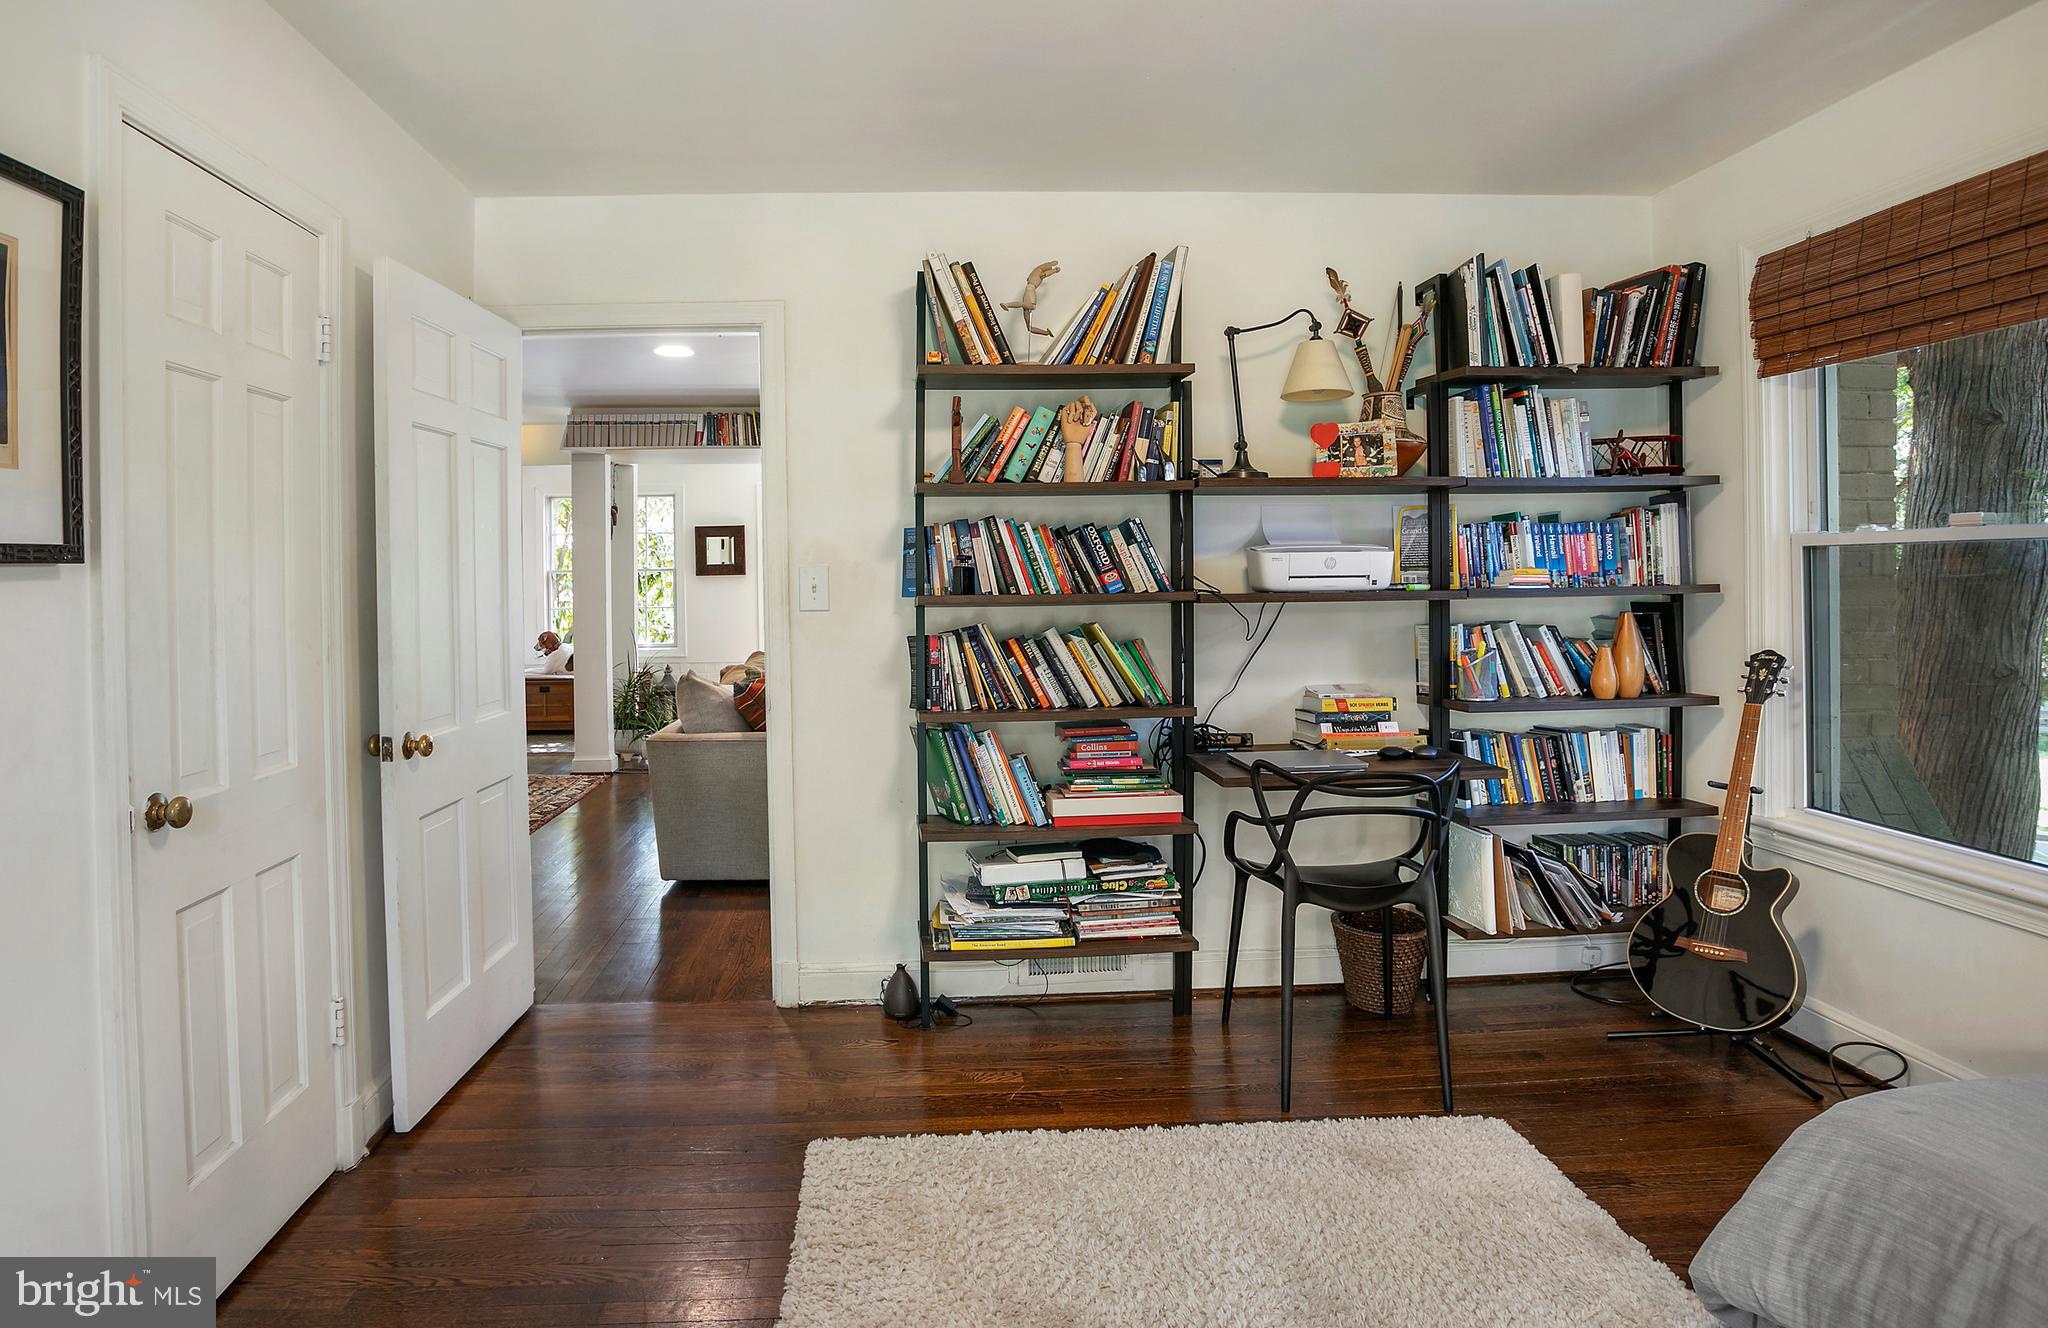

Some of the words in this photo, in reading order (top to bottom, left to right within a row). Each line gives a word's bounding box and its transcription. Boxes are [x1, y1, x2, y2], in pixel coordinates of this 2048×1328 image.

[974, 285, 982, 294] del
[1156, 262, 1172, 298] JOURNEYS
[979, 293, 990, 310] reyes
[1149, 305, 1163, 336] LIFETIME
[1666, 320, 1676, 341] WHERE
[1673, 291, 1682, 309] WHEN
[991, 324, 1000, 336] Los
[1046, 429, 1055, 442] SINS
[1032, 444, 1049, 472] SCRIPTURE
[1087, 524, 1110, 565] OXFORD
[1534, 534, 1542, 557] Ireland
[1605, 533, 1613, 559] Mexico
[1116, 541, 1135, 572] Sapiens
[1022, 642, 1035, 658] FERAL
[1045, 671, 1060, 695] EXODUS
[1031, 886, 1056, 894] Edition
[1101, 880, 1127, 891] Clue
